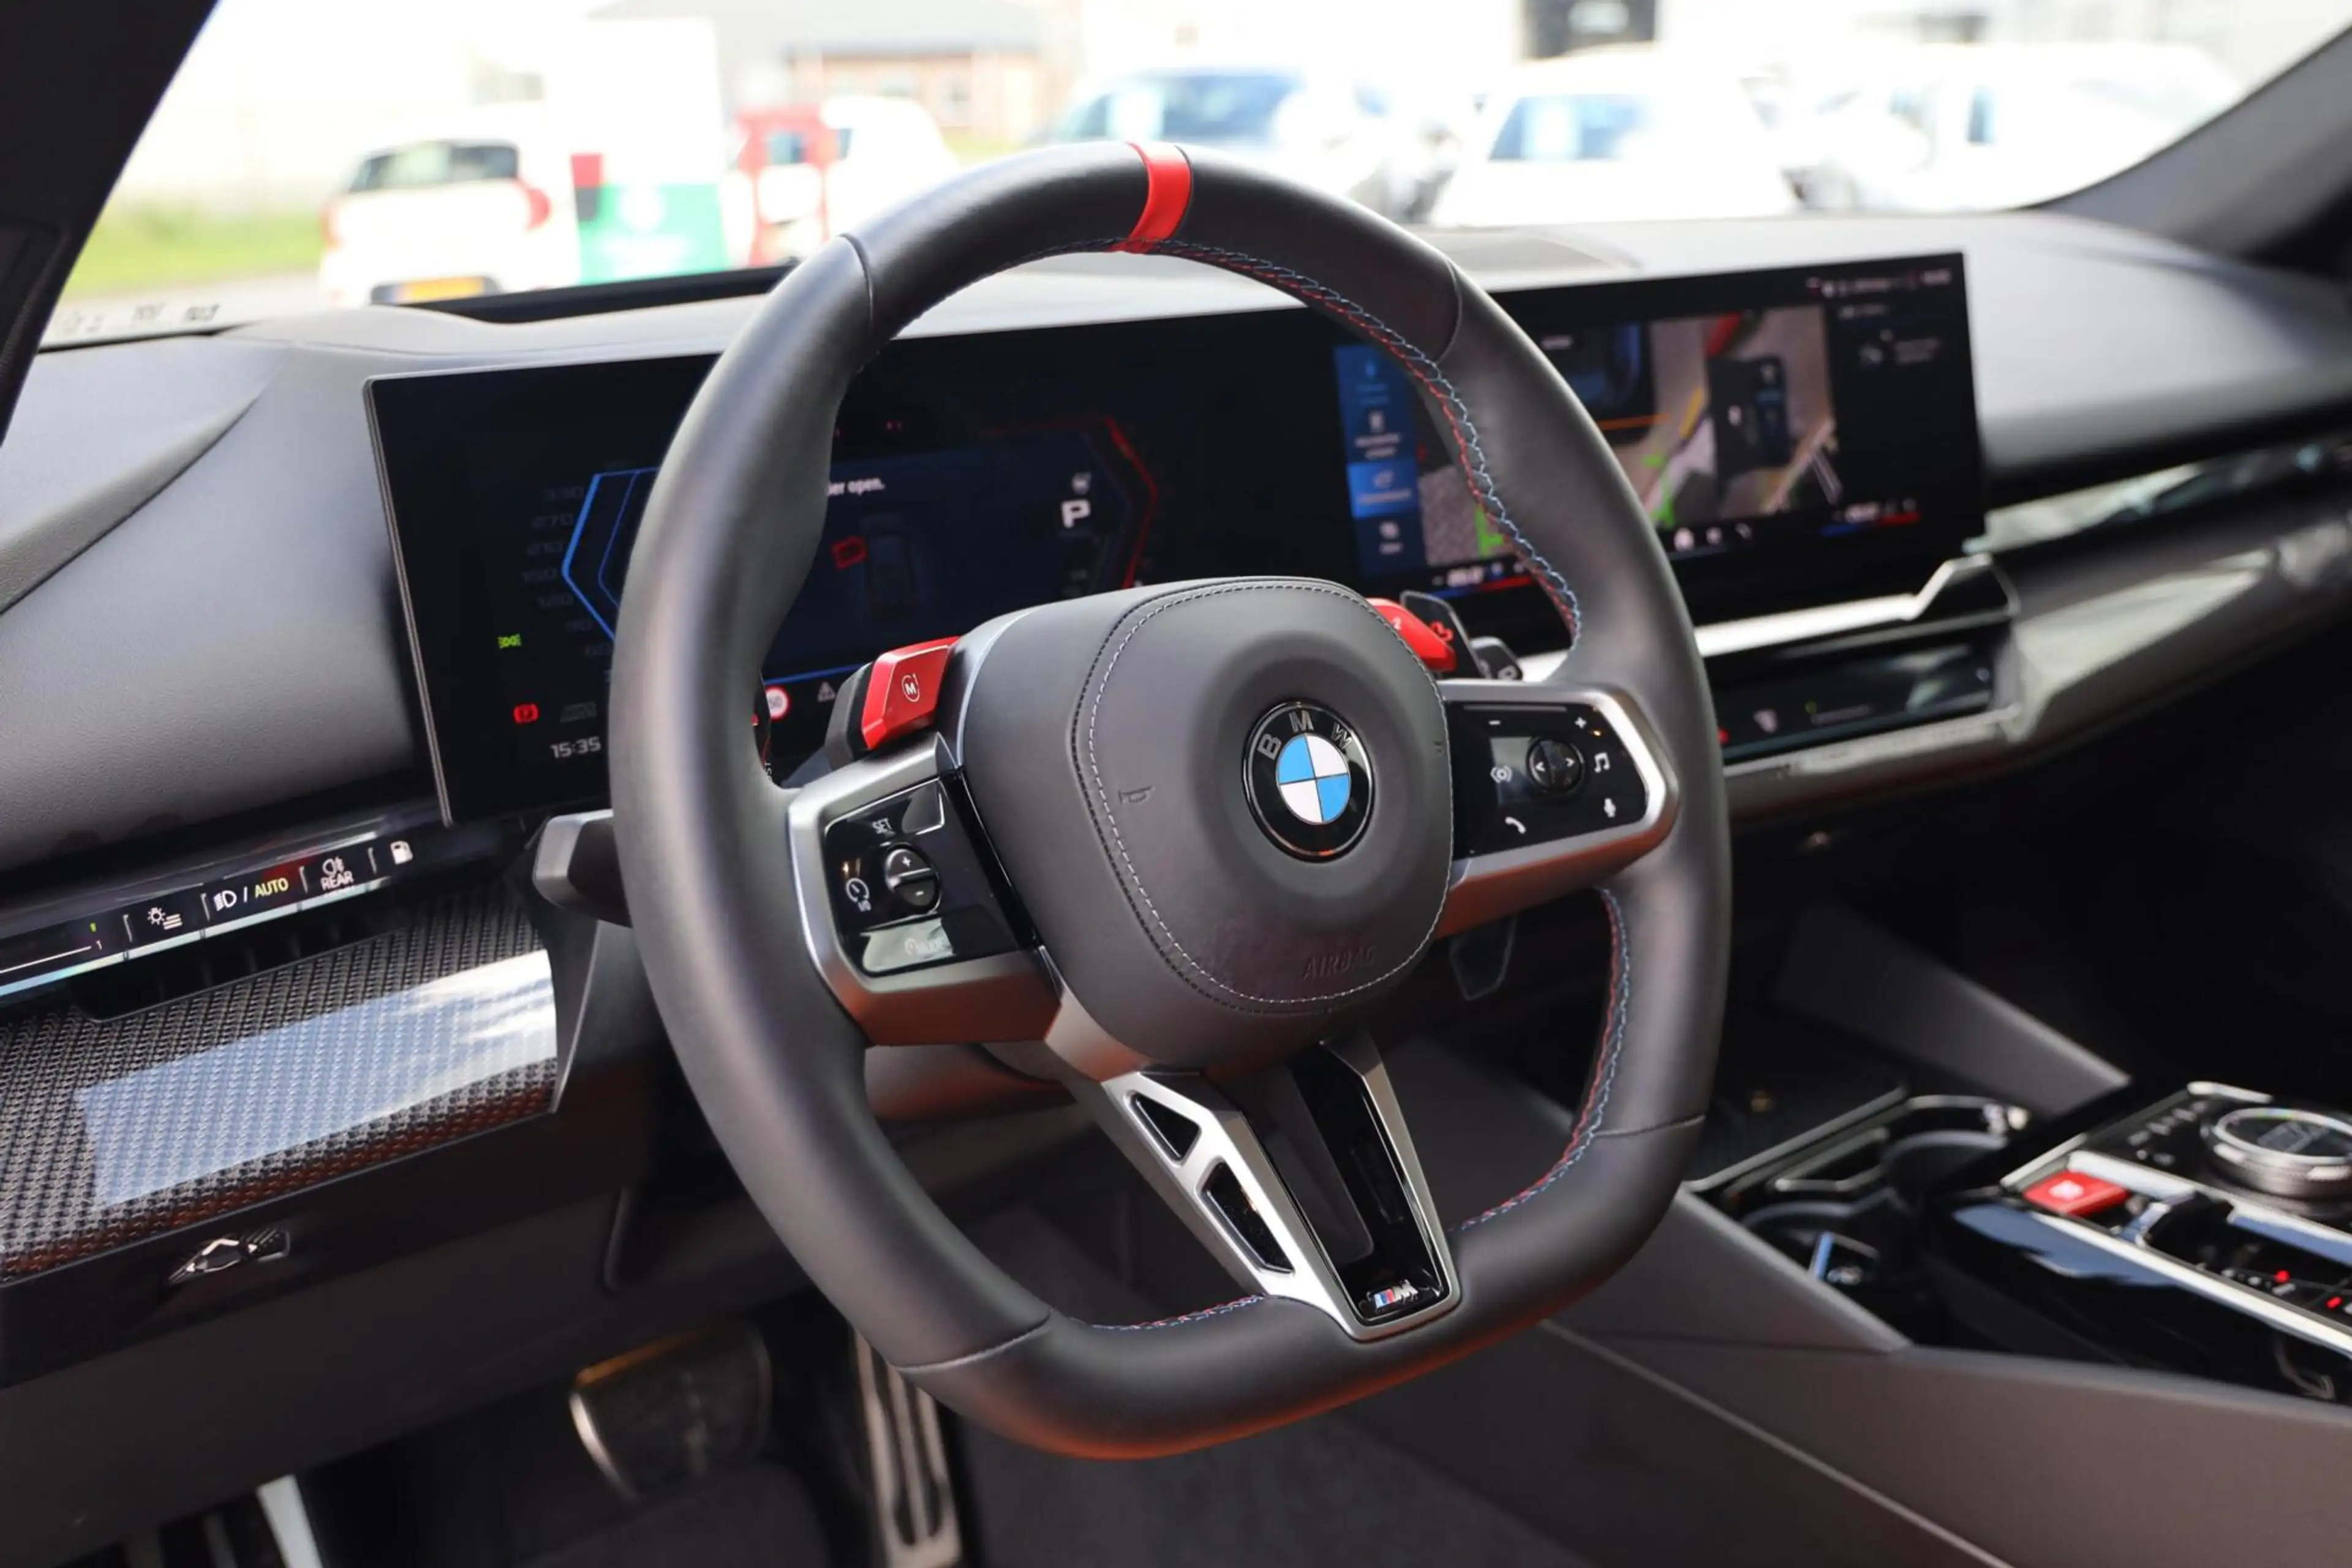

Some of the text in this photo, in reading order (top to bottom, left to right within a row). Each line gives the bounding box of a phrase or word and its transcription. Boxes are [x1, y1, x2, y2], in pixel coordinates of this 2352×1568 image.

[1061, 499, 1091, 529] P
[1256, 709, 1352, 760] BMW
[550, 736, 601, 758] 15:35
[872, 818, 892, 834] SET
[255, 877, 289, 899] AUTO
[320, 871, 354, 891] REAR
